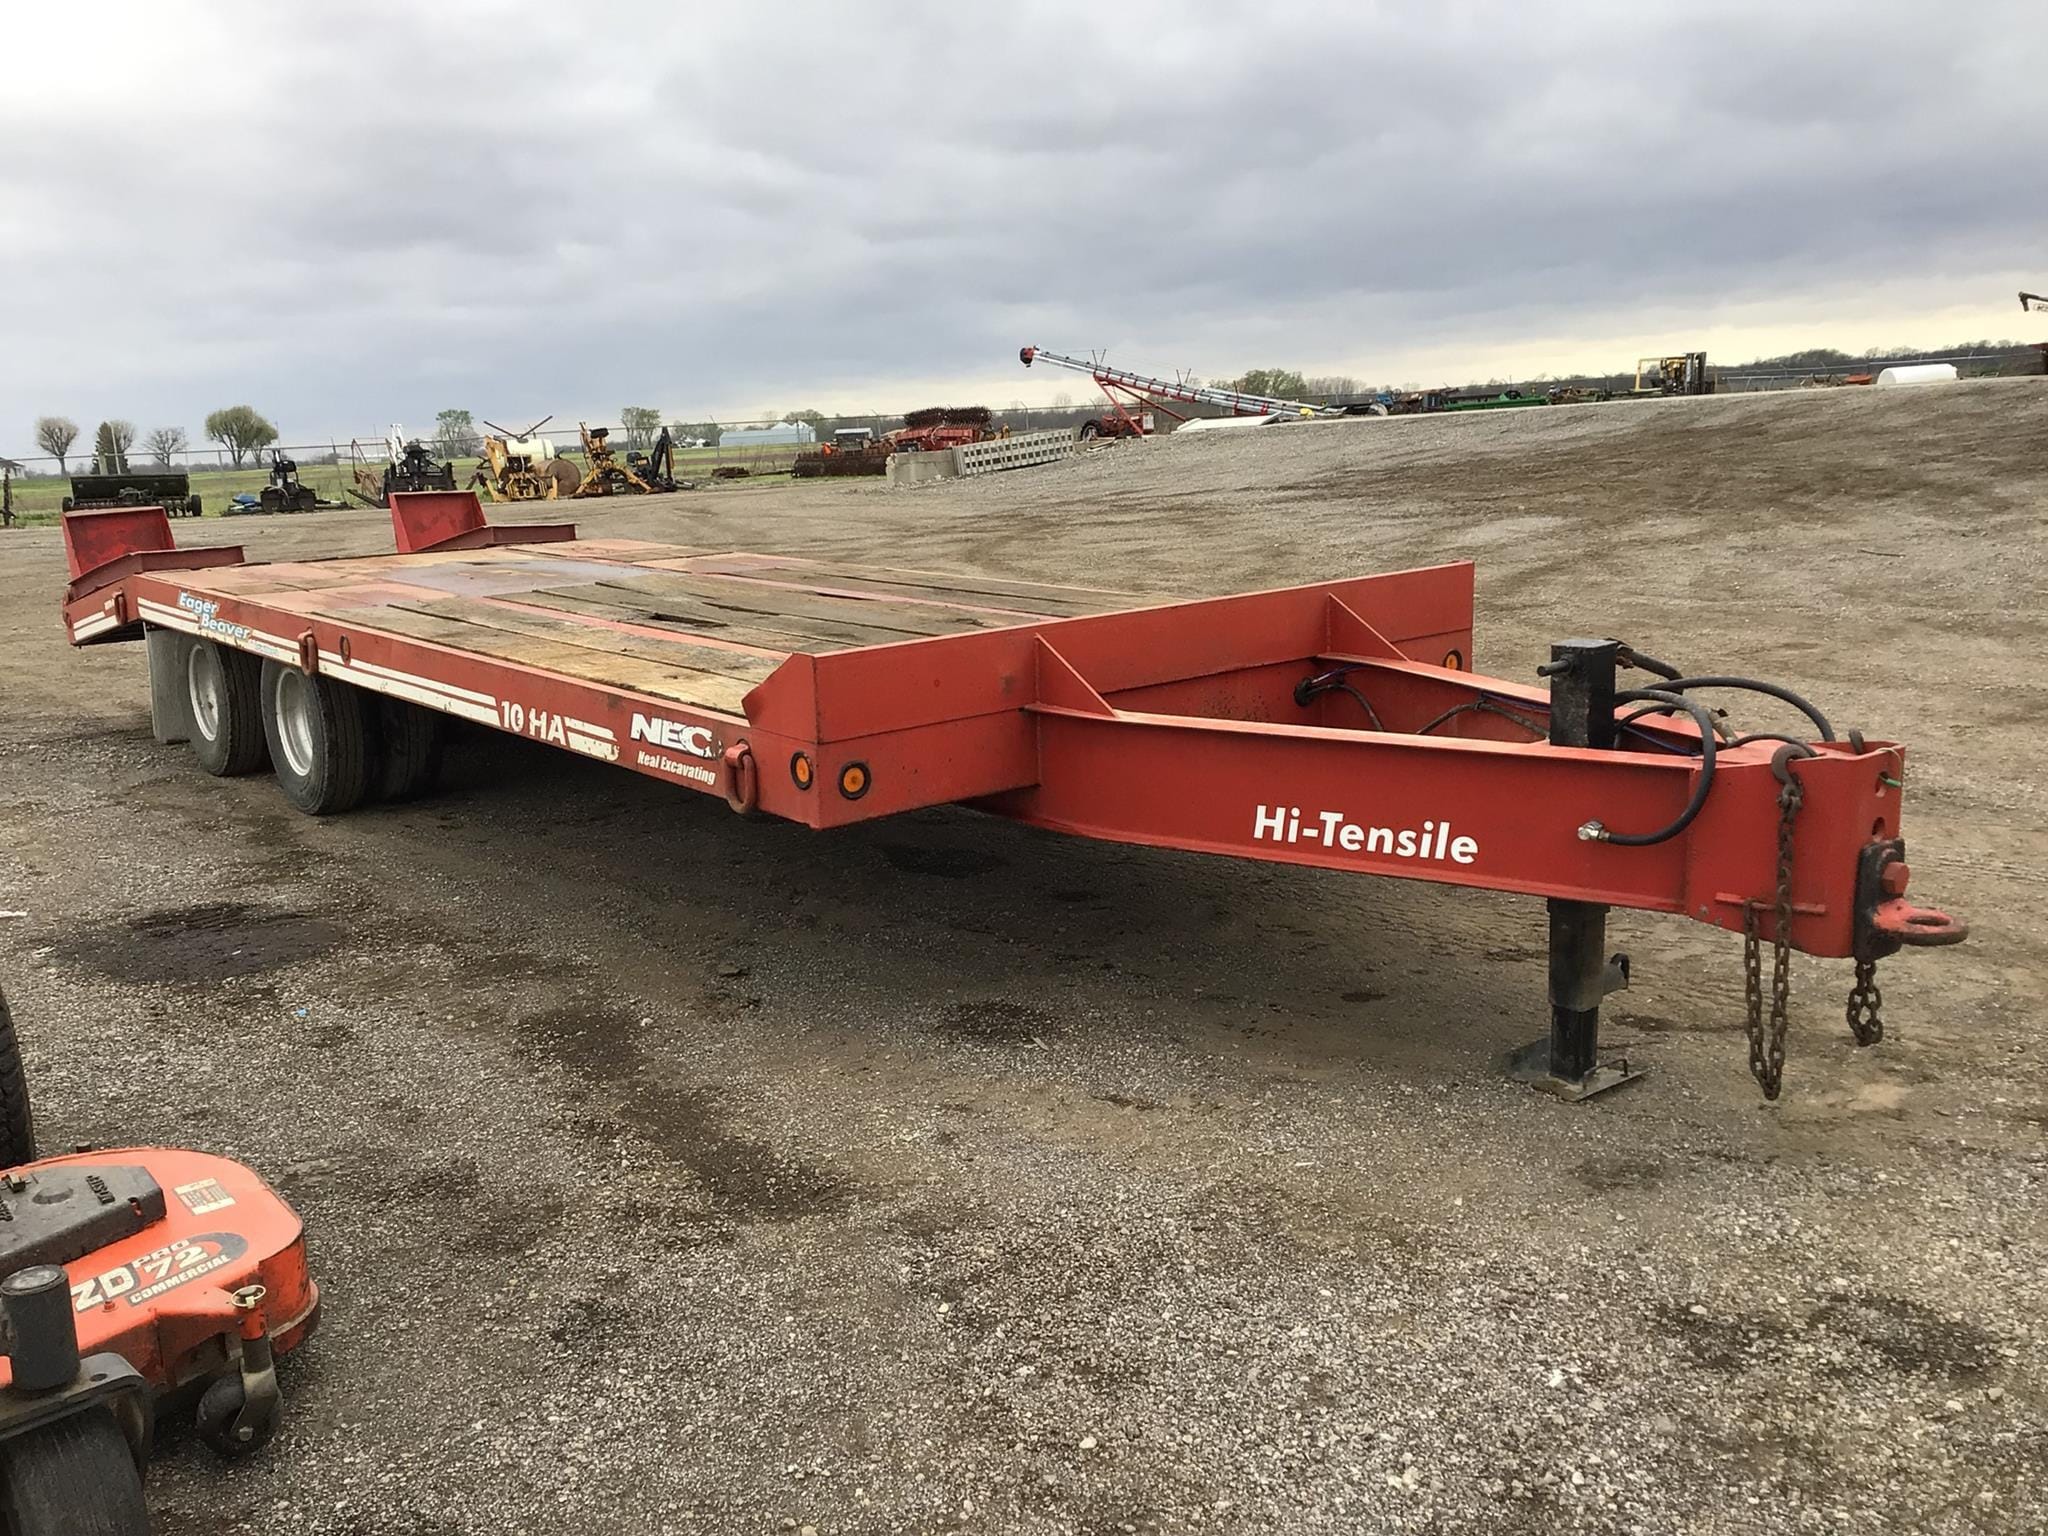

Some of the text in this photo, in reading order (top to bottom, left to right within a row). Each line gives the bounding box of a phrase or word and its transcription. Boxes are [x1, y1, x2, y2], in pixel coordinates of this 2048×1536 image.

[179, 591, 218, 614] Eager
[201, 612, 251, 640] Beaver
[501, 700, 567, 746] 10 HA
[637, 750, 716, 786] Neal Excavating
[1253, 804, 1479, 865] Hi-Tensile
[131, 1239, 191, 1269] PRO
[143, 1246, 209, 1280] 72
[70, 1267, 135, 1312] ZD
[129, 1254, 232, 1304] COMMERCIAL
